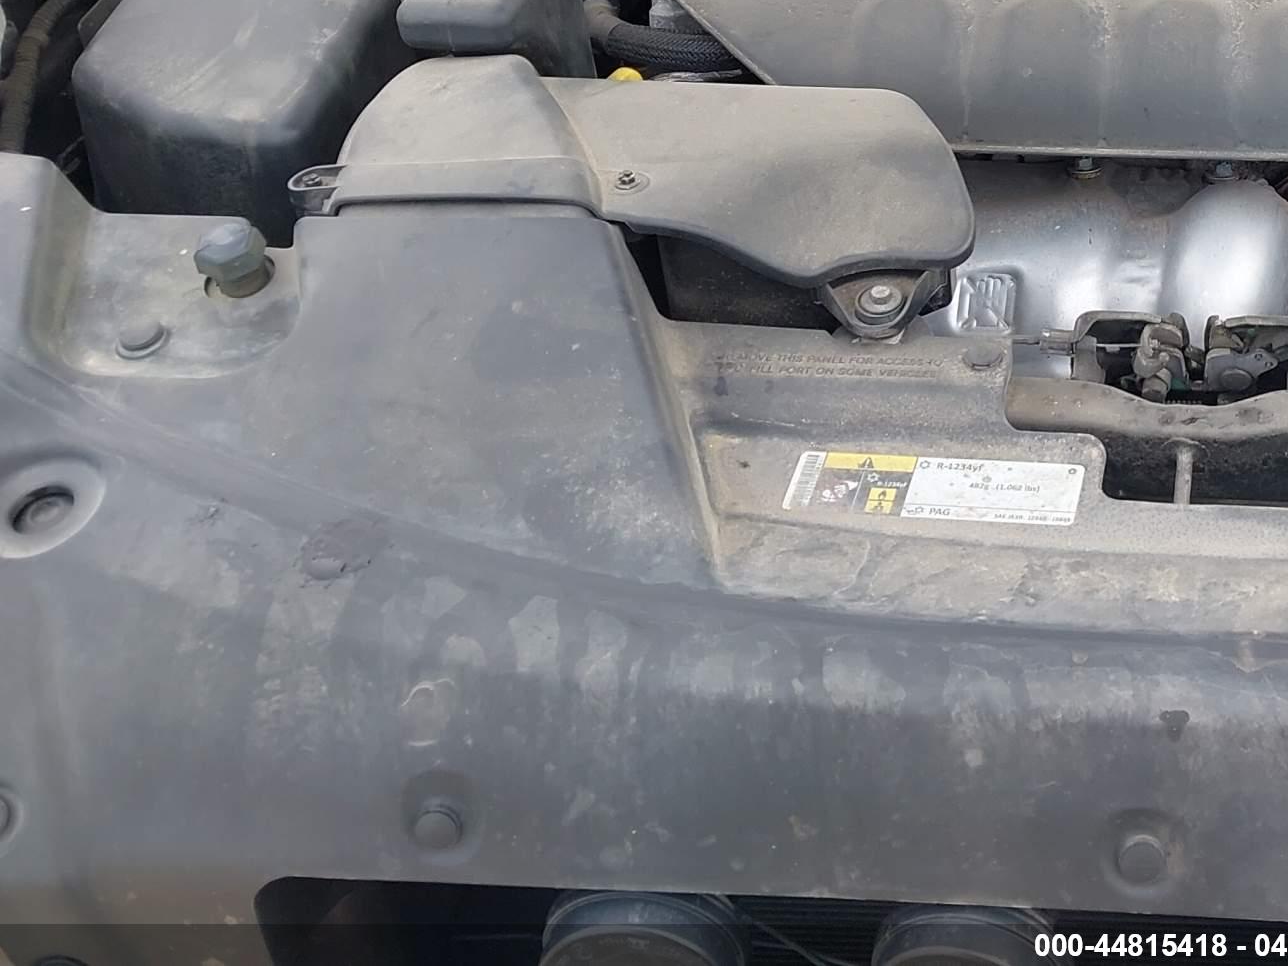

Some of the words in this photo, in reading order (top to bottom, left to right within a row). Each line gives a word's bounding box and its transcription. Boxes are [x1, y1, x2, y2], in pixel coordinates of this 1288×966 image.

[848, 355, 873, 365] FOR
[815, 366, 835, 377] ON
[837, 367, 873, 377] SOME
[936, 461, 985, 473] R-1234yf
[928, 507, 951, 517] PAG
